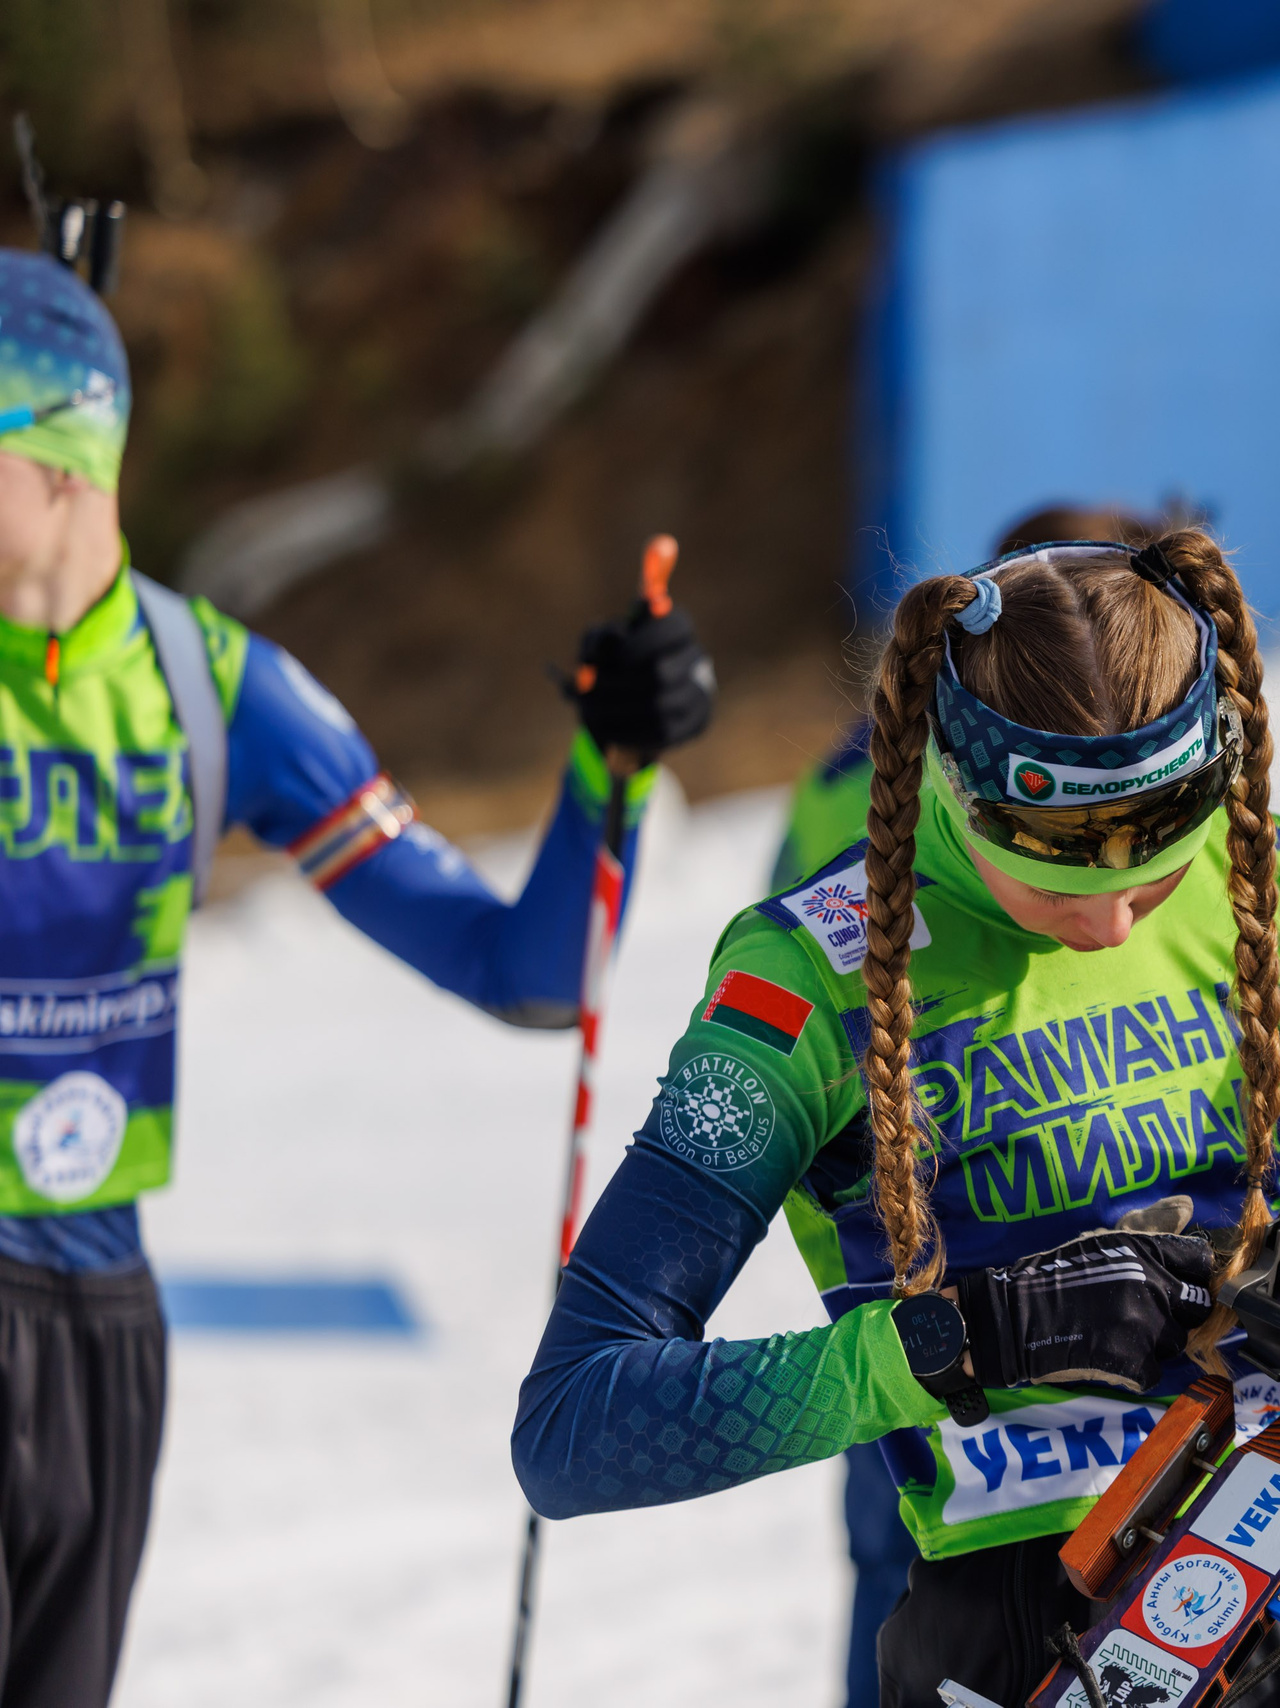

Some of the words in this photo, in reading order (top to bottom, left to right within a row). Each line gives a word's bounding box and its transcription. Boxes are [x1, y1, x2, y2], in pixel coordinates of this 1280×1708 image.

[1062, 738, 1203, 796] БЕЛОРУСНЕФТЬ
[683, 1056, 768, 1105] BIATHLON
[702, 1151, 720, 1166] of
[725, 1117, 770, 1166] Belarus
[1054, 1333, 1085, 1344] Breeze
[1174, 1559, 1237, 1583] Богалий
[1146, 1572, 1172, 1609] Анны
[1150, 1613, 1190, 1643] Кубок
[1207, 1597, 1241, 1636] Skimir
